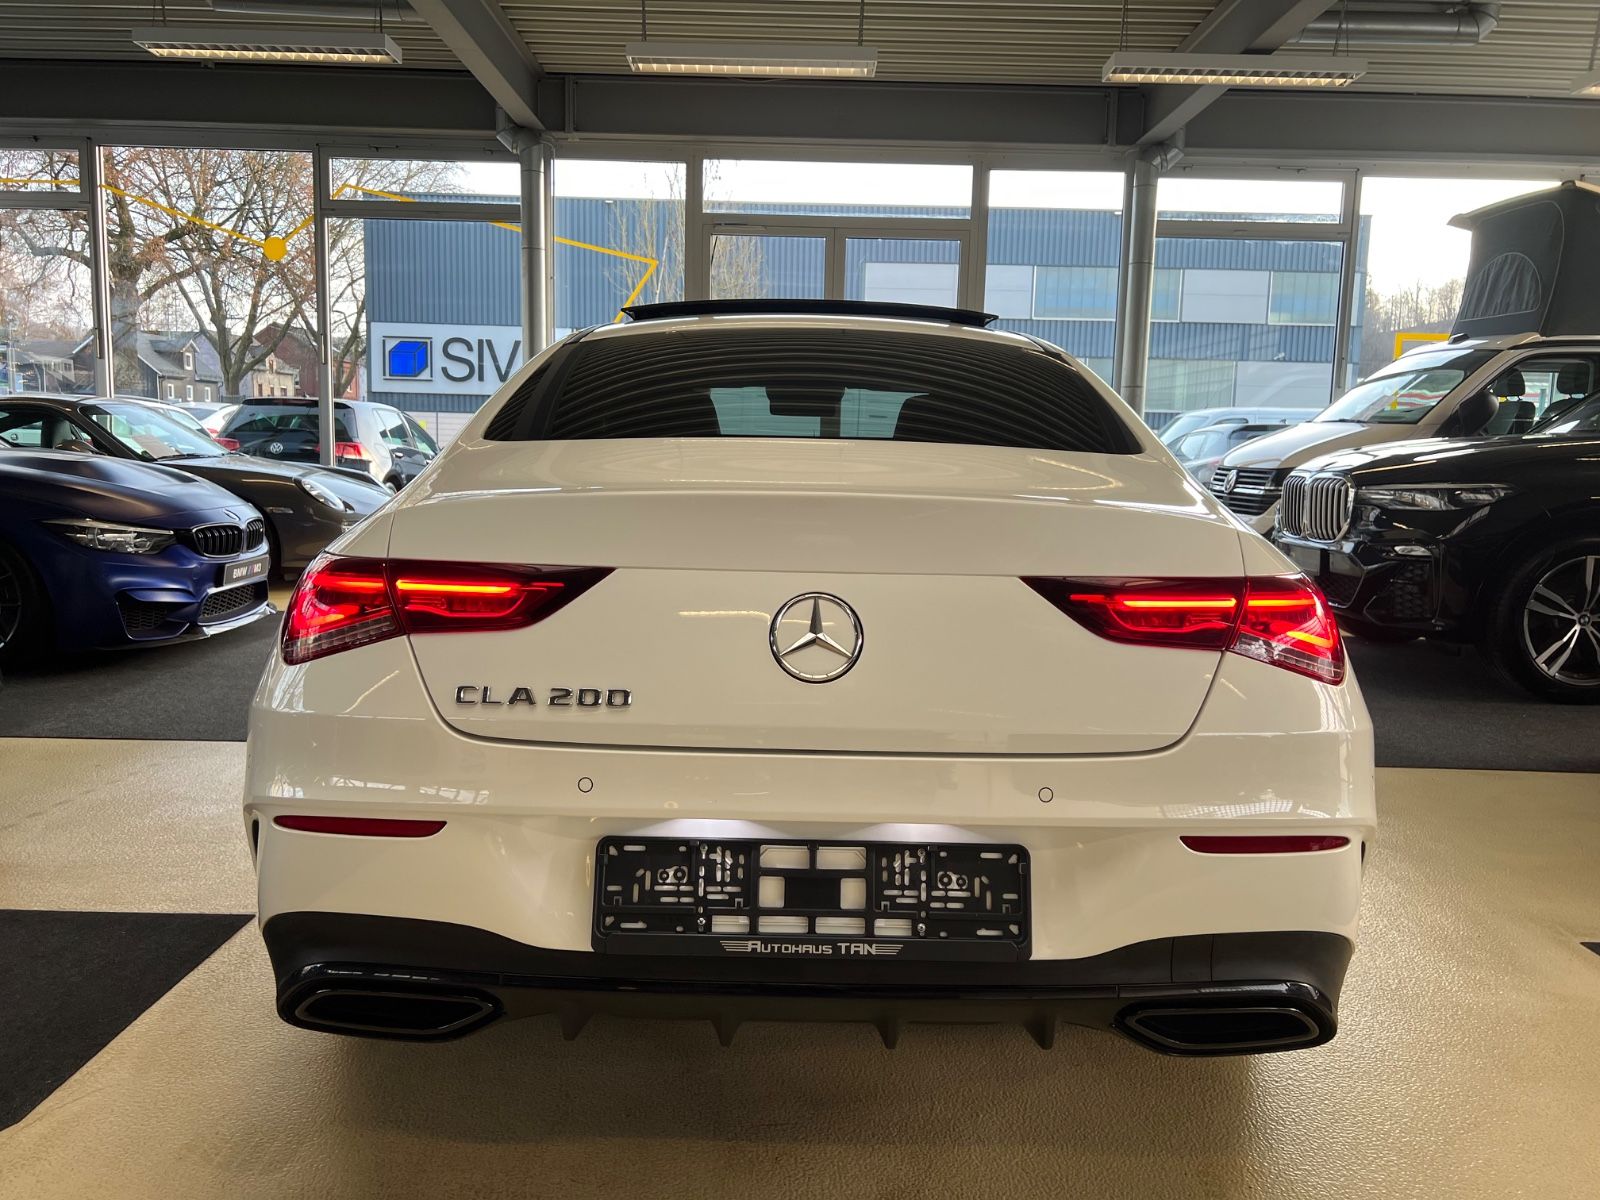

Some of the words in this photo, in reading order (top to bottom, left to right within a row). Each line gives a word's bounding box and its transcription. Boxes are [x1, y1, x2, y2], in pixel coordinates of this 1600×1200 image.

[441, 337, 521, 382] SIV
[233, 565, 248, 579] BMW
[455, 685, 537, 706] CLA
[547, 686, 632, 707] 200
[837, 942, 876, 955] TAN
